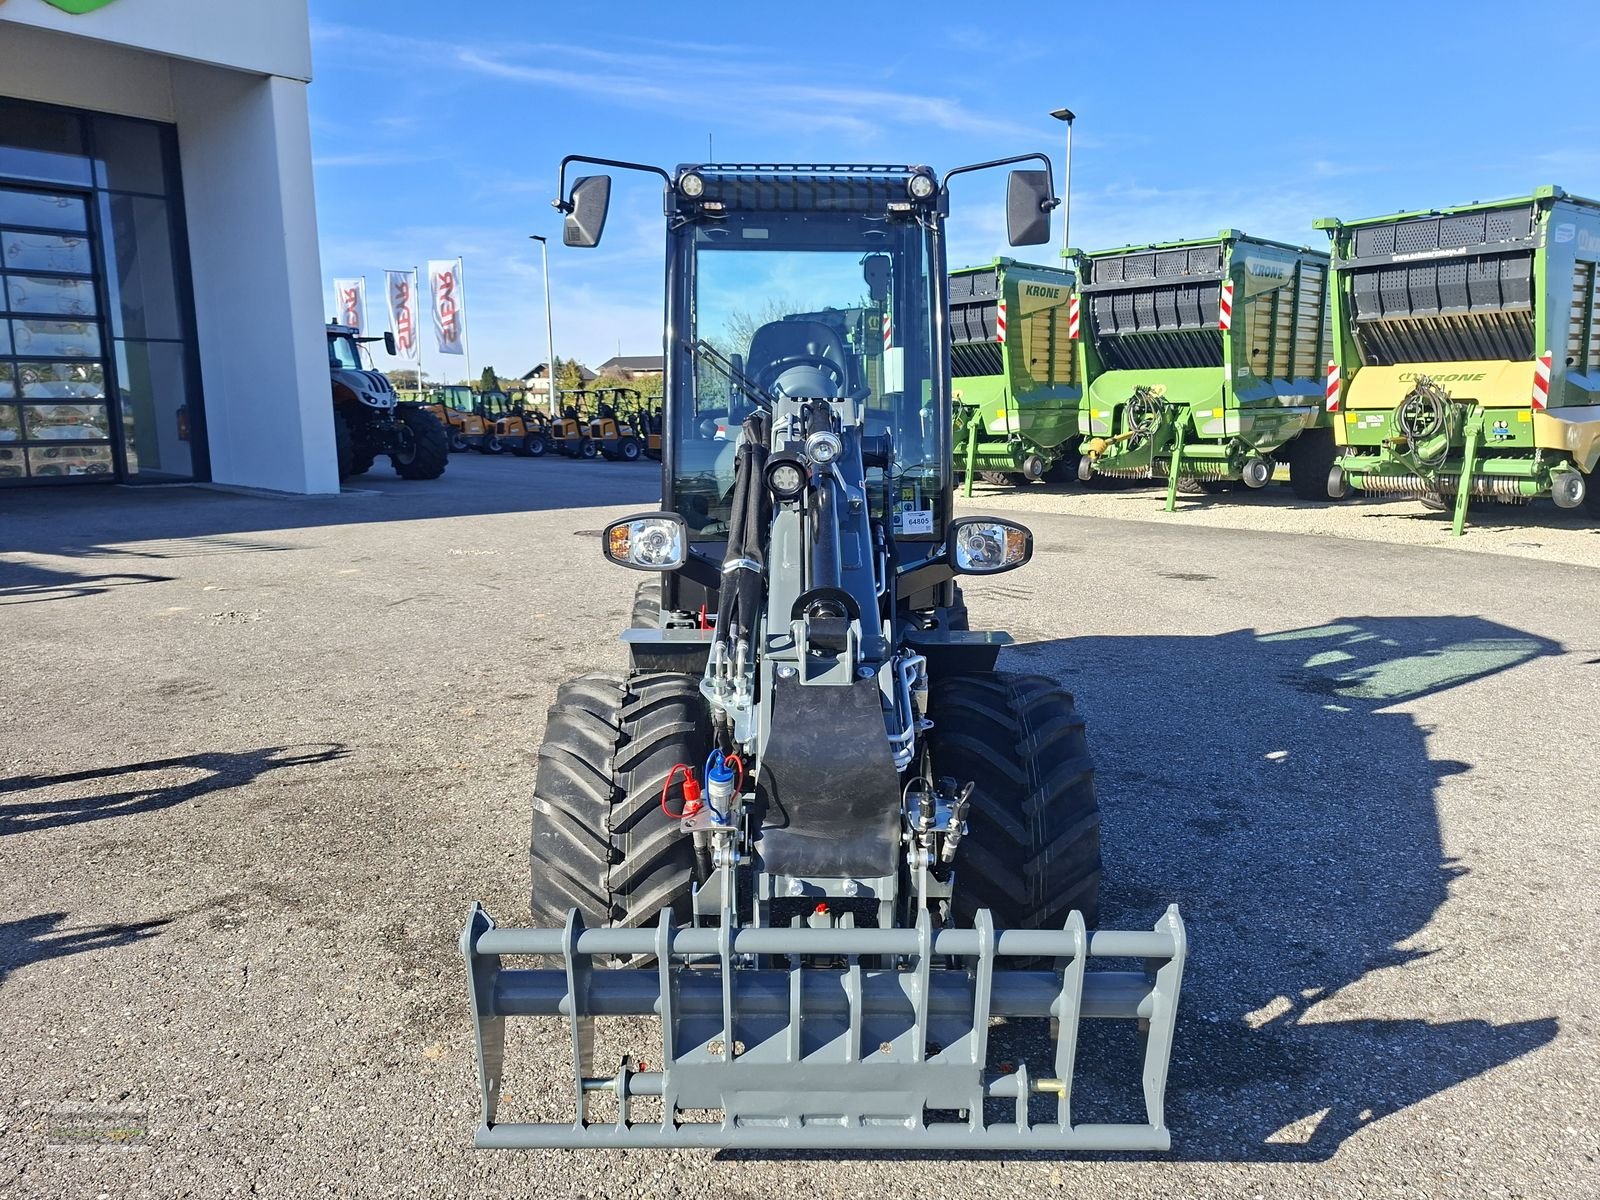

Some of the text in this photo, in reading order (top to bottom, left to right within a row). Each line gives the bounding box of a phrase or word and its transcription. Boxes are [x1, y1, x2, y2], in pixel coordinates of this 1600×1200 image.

[1252, 263, 1283, 279] KRONE
[1025, 284, 1060, 299] KRONE
[908, 518, 930, 526] 64805
